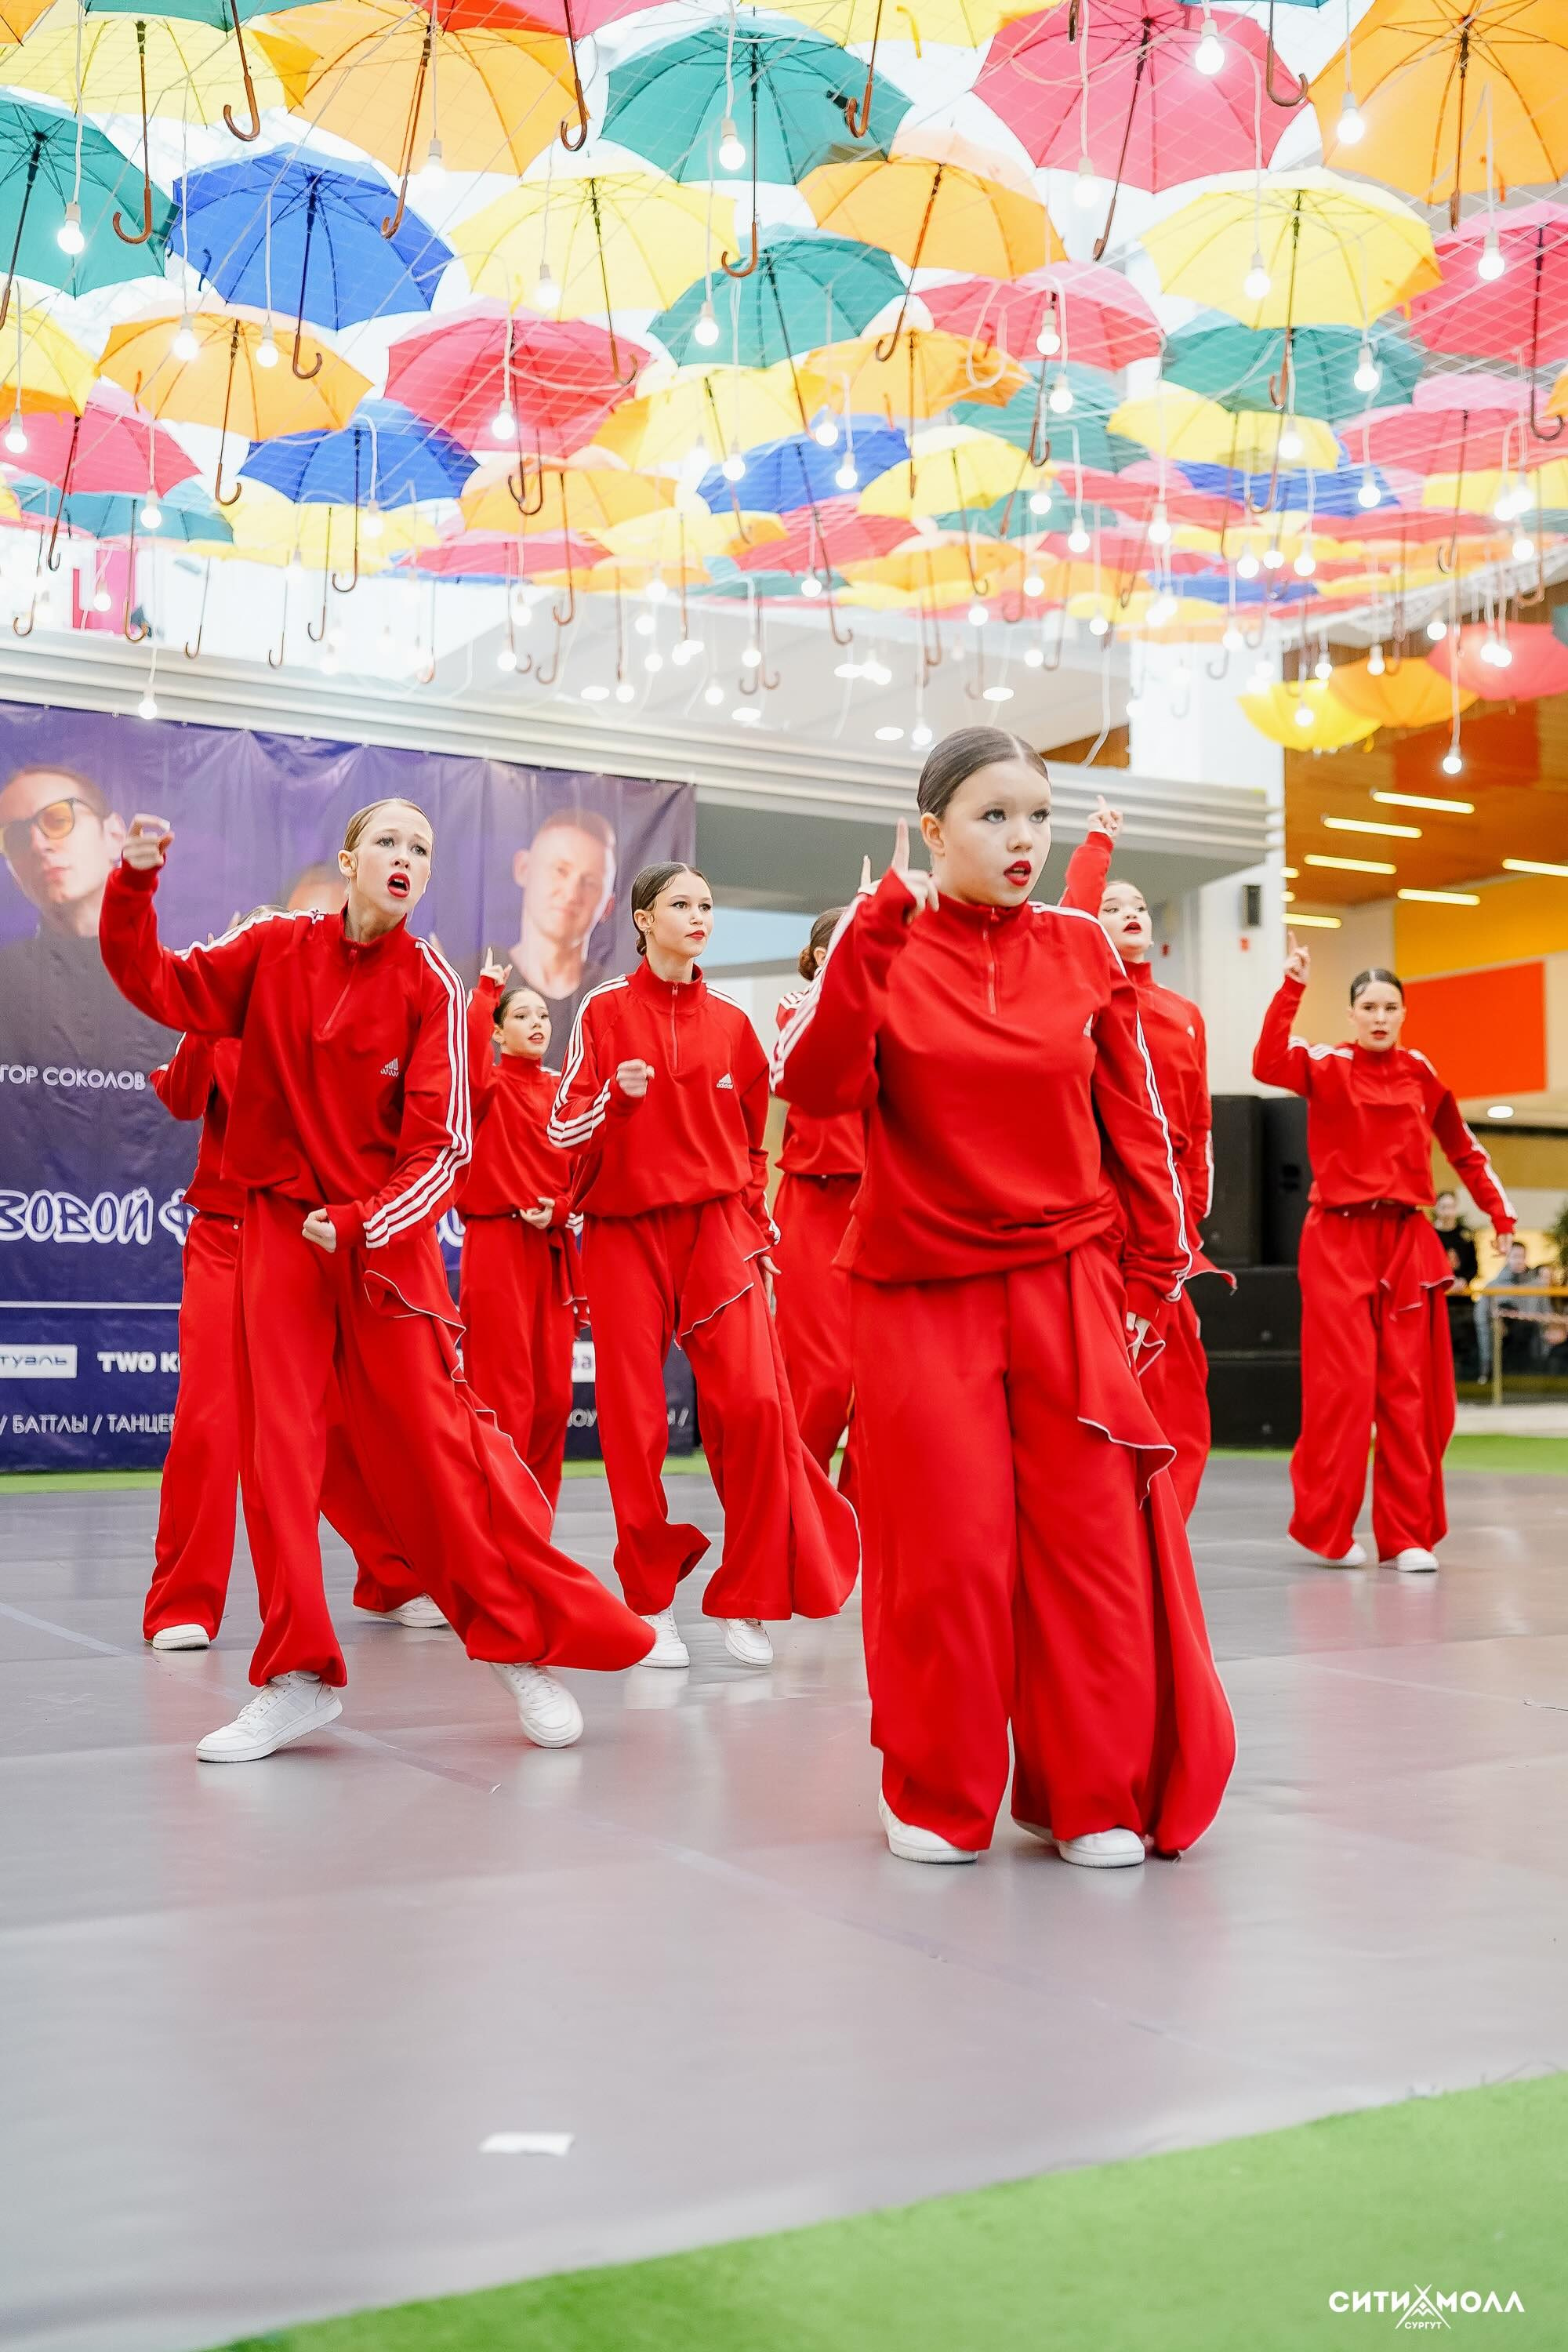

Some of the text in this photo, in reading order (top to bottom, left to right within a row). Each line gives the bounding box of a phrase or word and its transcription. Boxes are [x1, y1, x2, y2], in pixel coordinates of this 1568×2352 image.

[42, 1066, 147, 1091] СОКОЛОВ
[97, 1351, 157, 1373] TWO
[13, 1414, 89, 1434] БАТТЛЫ
